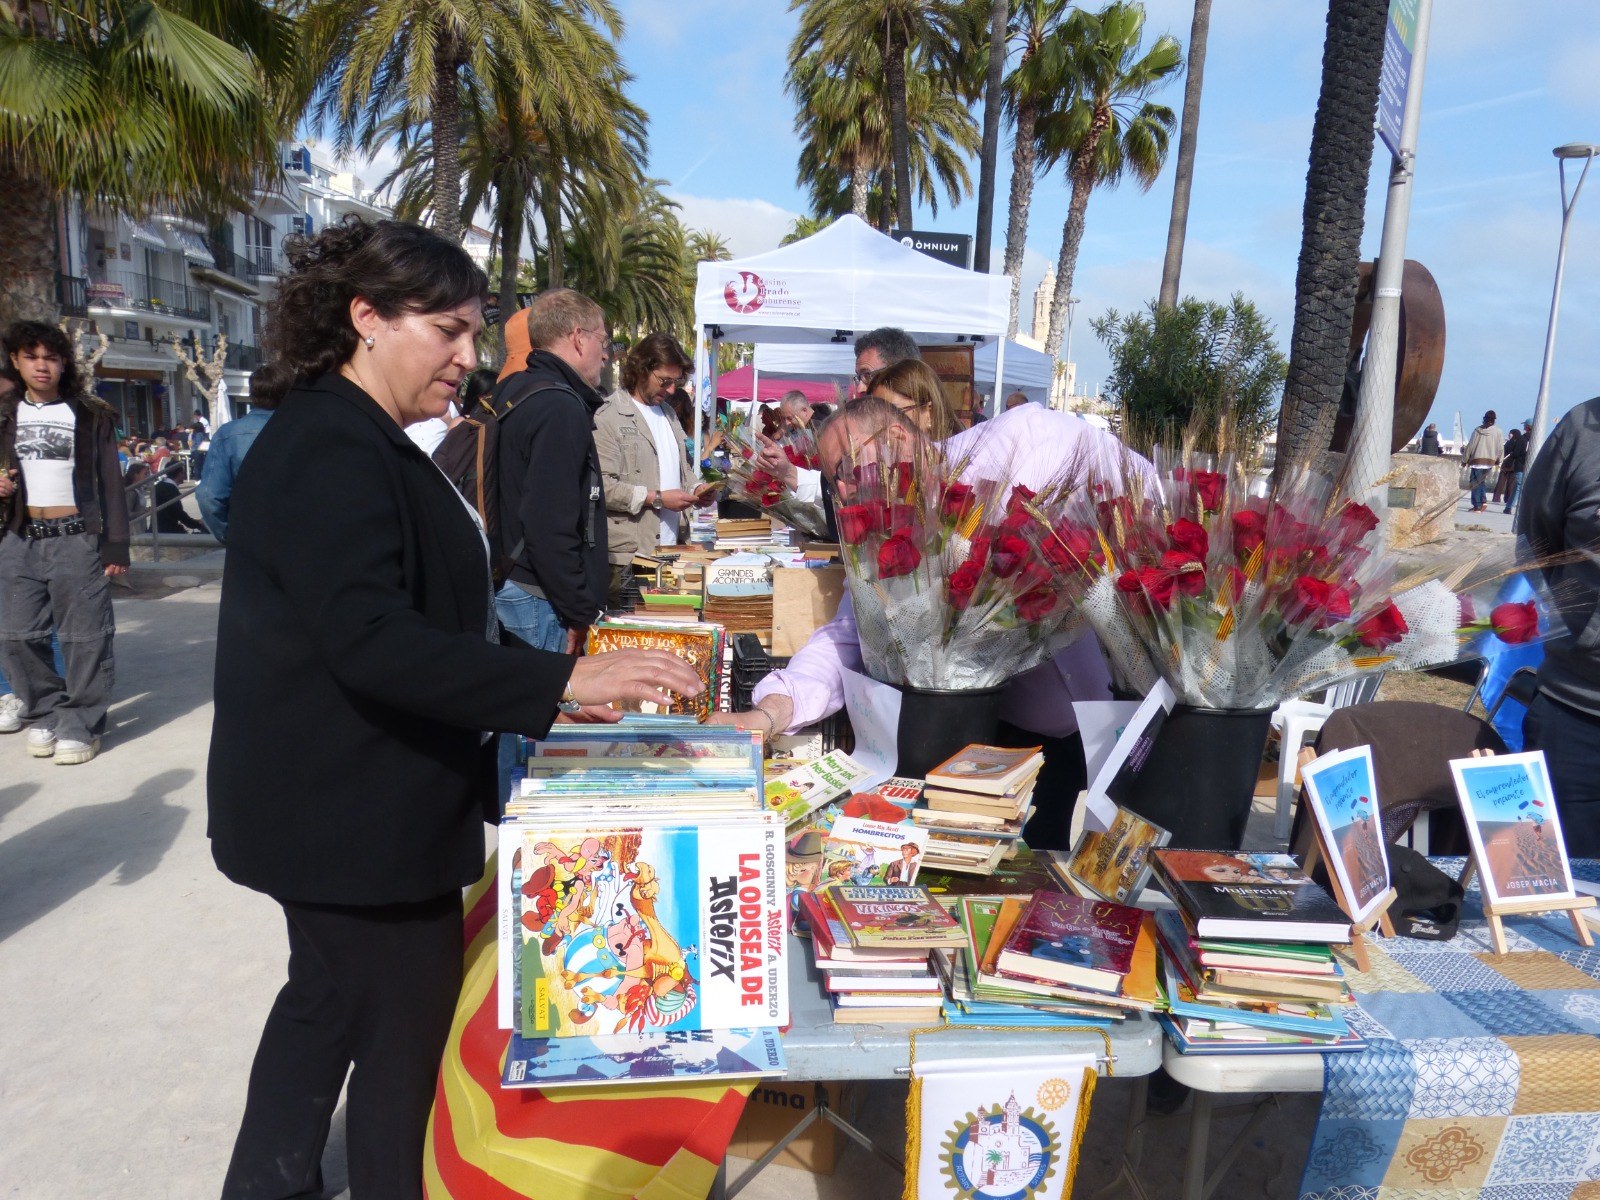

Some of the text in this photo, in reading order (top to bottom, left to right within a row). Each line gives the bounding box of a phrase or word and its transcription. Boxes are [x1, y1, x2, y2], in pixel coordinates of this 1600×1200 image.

[915, 239, 959, 252] ÒMNIUM
[717, 568, 754, 578] GRANDES
[595, 634, 676, 649] LA VIDA DE LOS
[823, 755, 844, 774] Mary
[764, 830, 775, 842] R.
[852, 827, 906, 841] HOMBRECITOS
[738, 853, 761, 883] LA
[765, 844, 776, 907] GOSCINNY
[1212, 886, 1296, 896] Mujercitas
[1506, 879, 1531, 890] JOSEP
[855, 902, 924, 915] VIKINGOS
[1039, 900, 1113, 918] Molly
[738, 885, 763, 972] ODISEA
[1050, 911, 1134, 937] Moon
[768, 954, 777, 966] A.
[740, 976, 763, 1007] DE
[768, 967, 779, 1019] UDERZO
[538, 987, 546, 1021] SALVAT
[764, 1038, 780, 1067] UDERZO
[956, 1165, 970, 1190] ROTARY
[1032, 1164, 1047, 1186] SITGES
